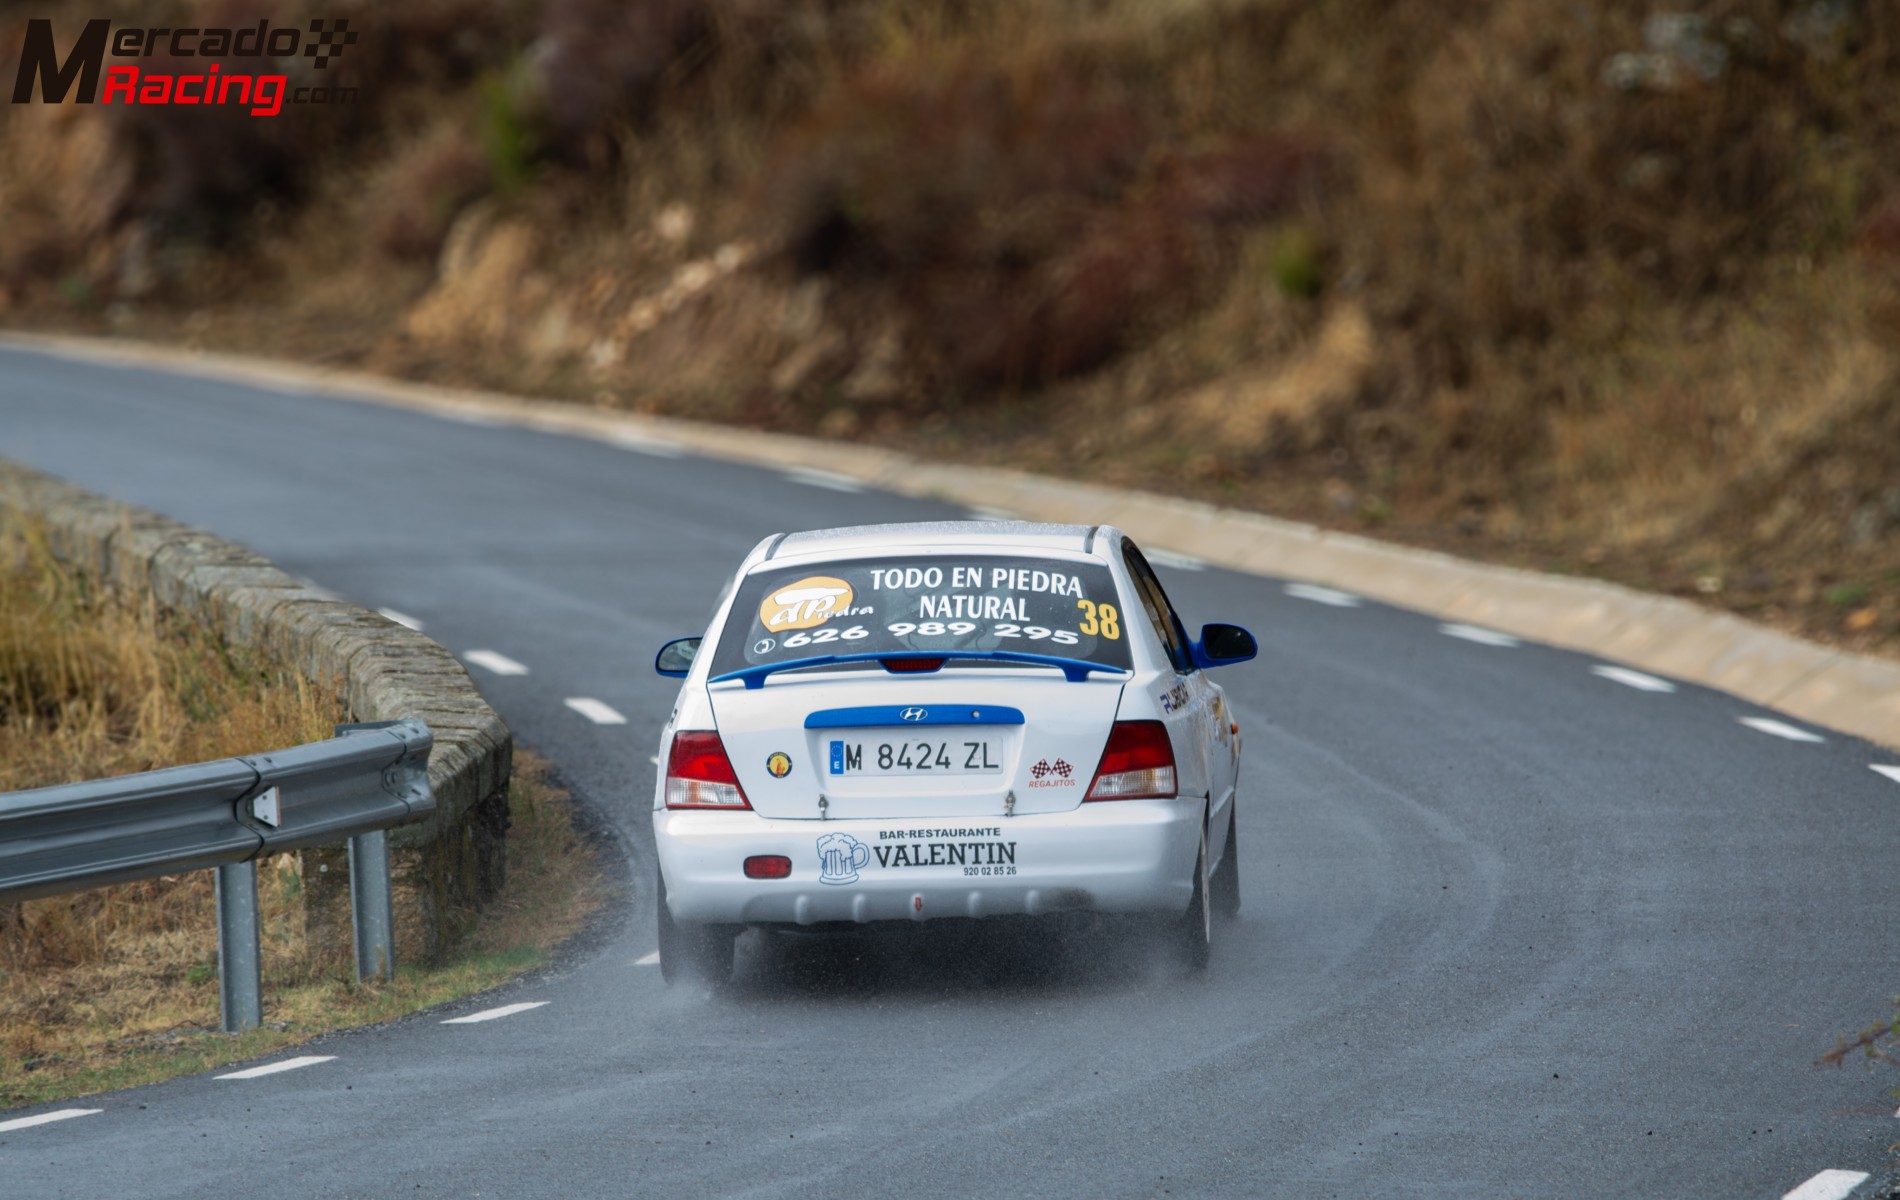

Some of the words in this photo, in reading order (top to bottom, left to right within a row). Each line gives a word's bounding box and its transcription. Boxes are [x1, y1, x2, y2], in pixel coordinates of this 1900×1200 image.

[870, 567, 943, 590] TODO
[952, 567, 983, 589] EN
[992, 568, 1083, 599] PIEDRA
[919, 595, 1031, 622] NATURAL
[1077, 599, 1120, 641] 38
[783, 625, 869, 648] 626
[887, 622, 977, 637] 989
[993, 623, 1079, 645] 295
[833, 761, 841, 770] E
[845, 743, 862, 771] M
[877, 742, 951, 770] 8424
[963, 742, 999, 769] ZL
[1028, 779, 1077, 788] REGAJITOS
[879, 827, 1001, 840] BAR-RESTAURANTE
[873, 842, 1017, 868] VALENTIN
[963, 867, 979, 876] 920
[981, 867, 992, 876] 02
[993, 866, 1004, 875] 85
[1006, 866, 1017, 875] 26
